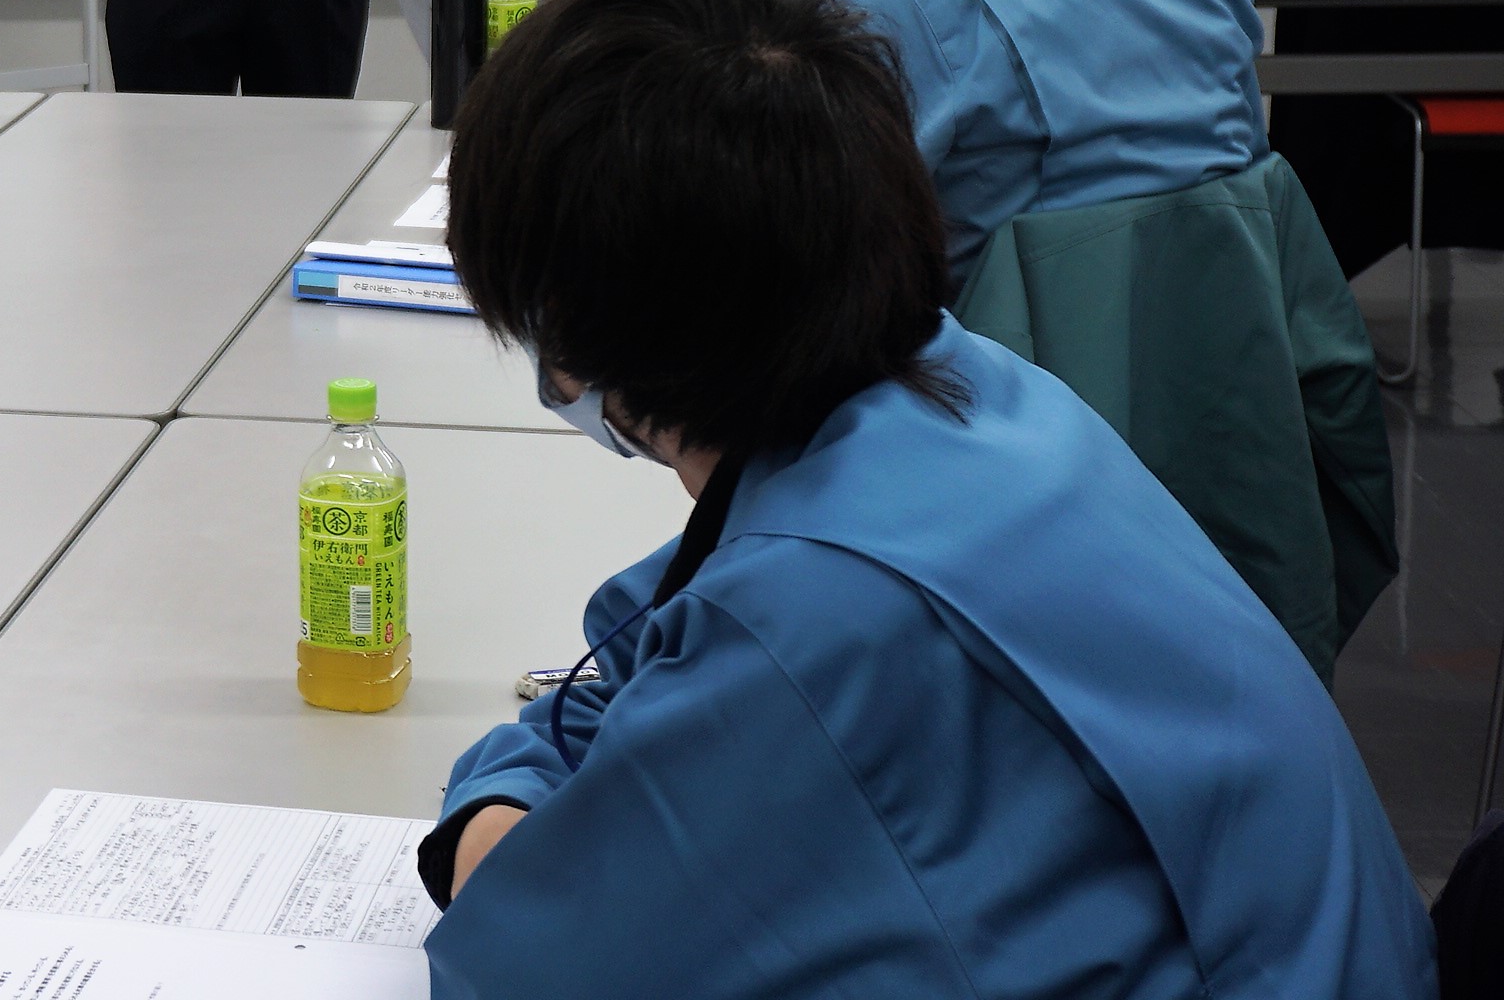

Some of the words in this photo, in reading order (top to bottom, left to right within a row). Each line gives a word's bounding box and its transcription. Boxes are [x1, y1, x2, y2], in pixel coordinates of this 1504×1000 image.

[353, 511, 368, 536] 京都
[313, 540, 368, 555] 伊右衛門
[314, 554, 354, 565] いえもん
[384, 562, 394, 620] いえもん
